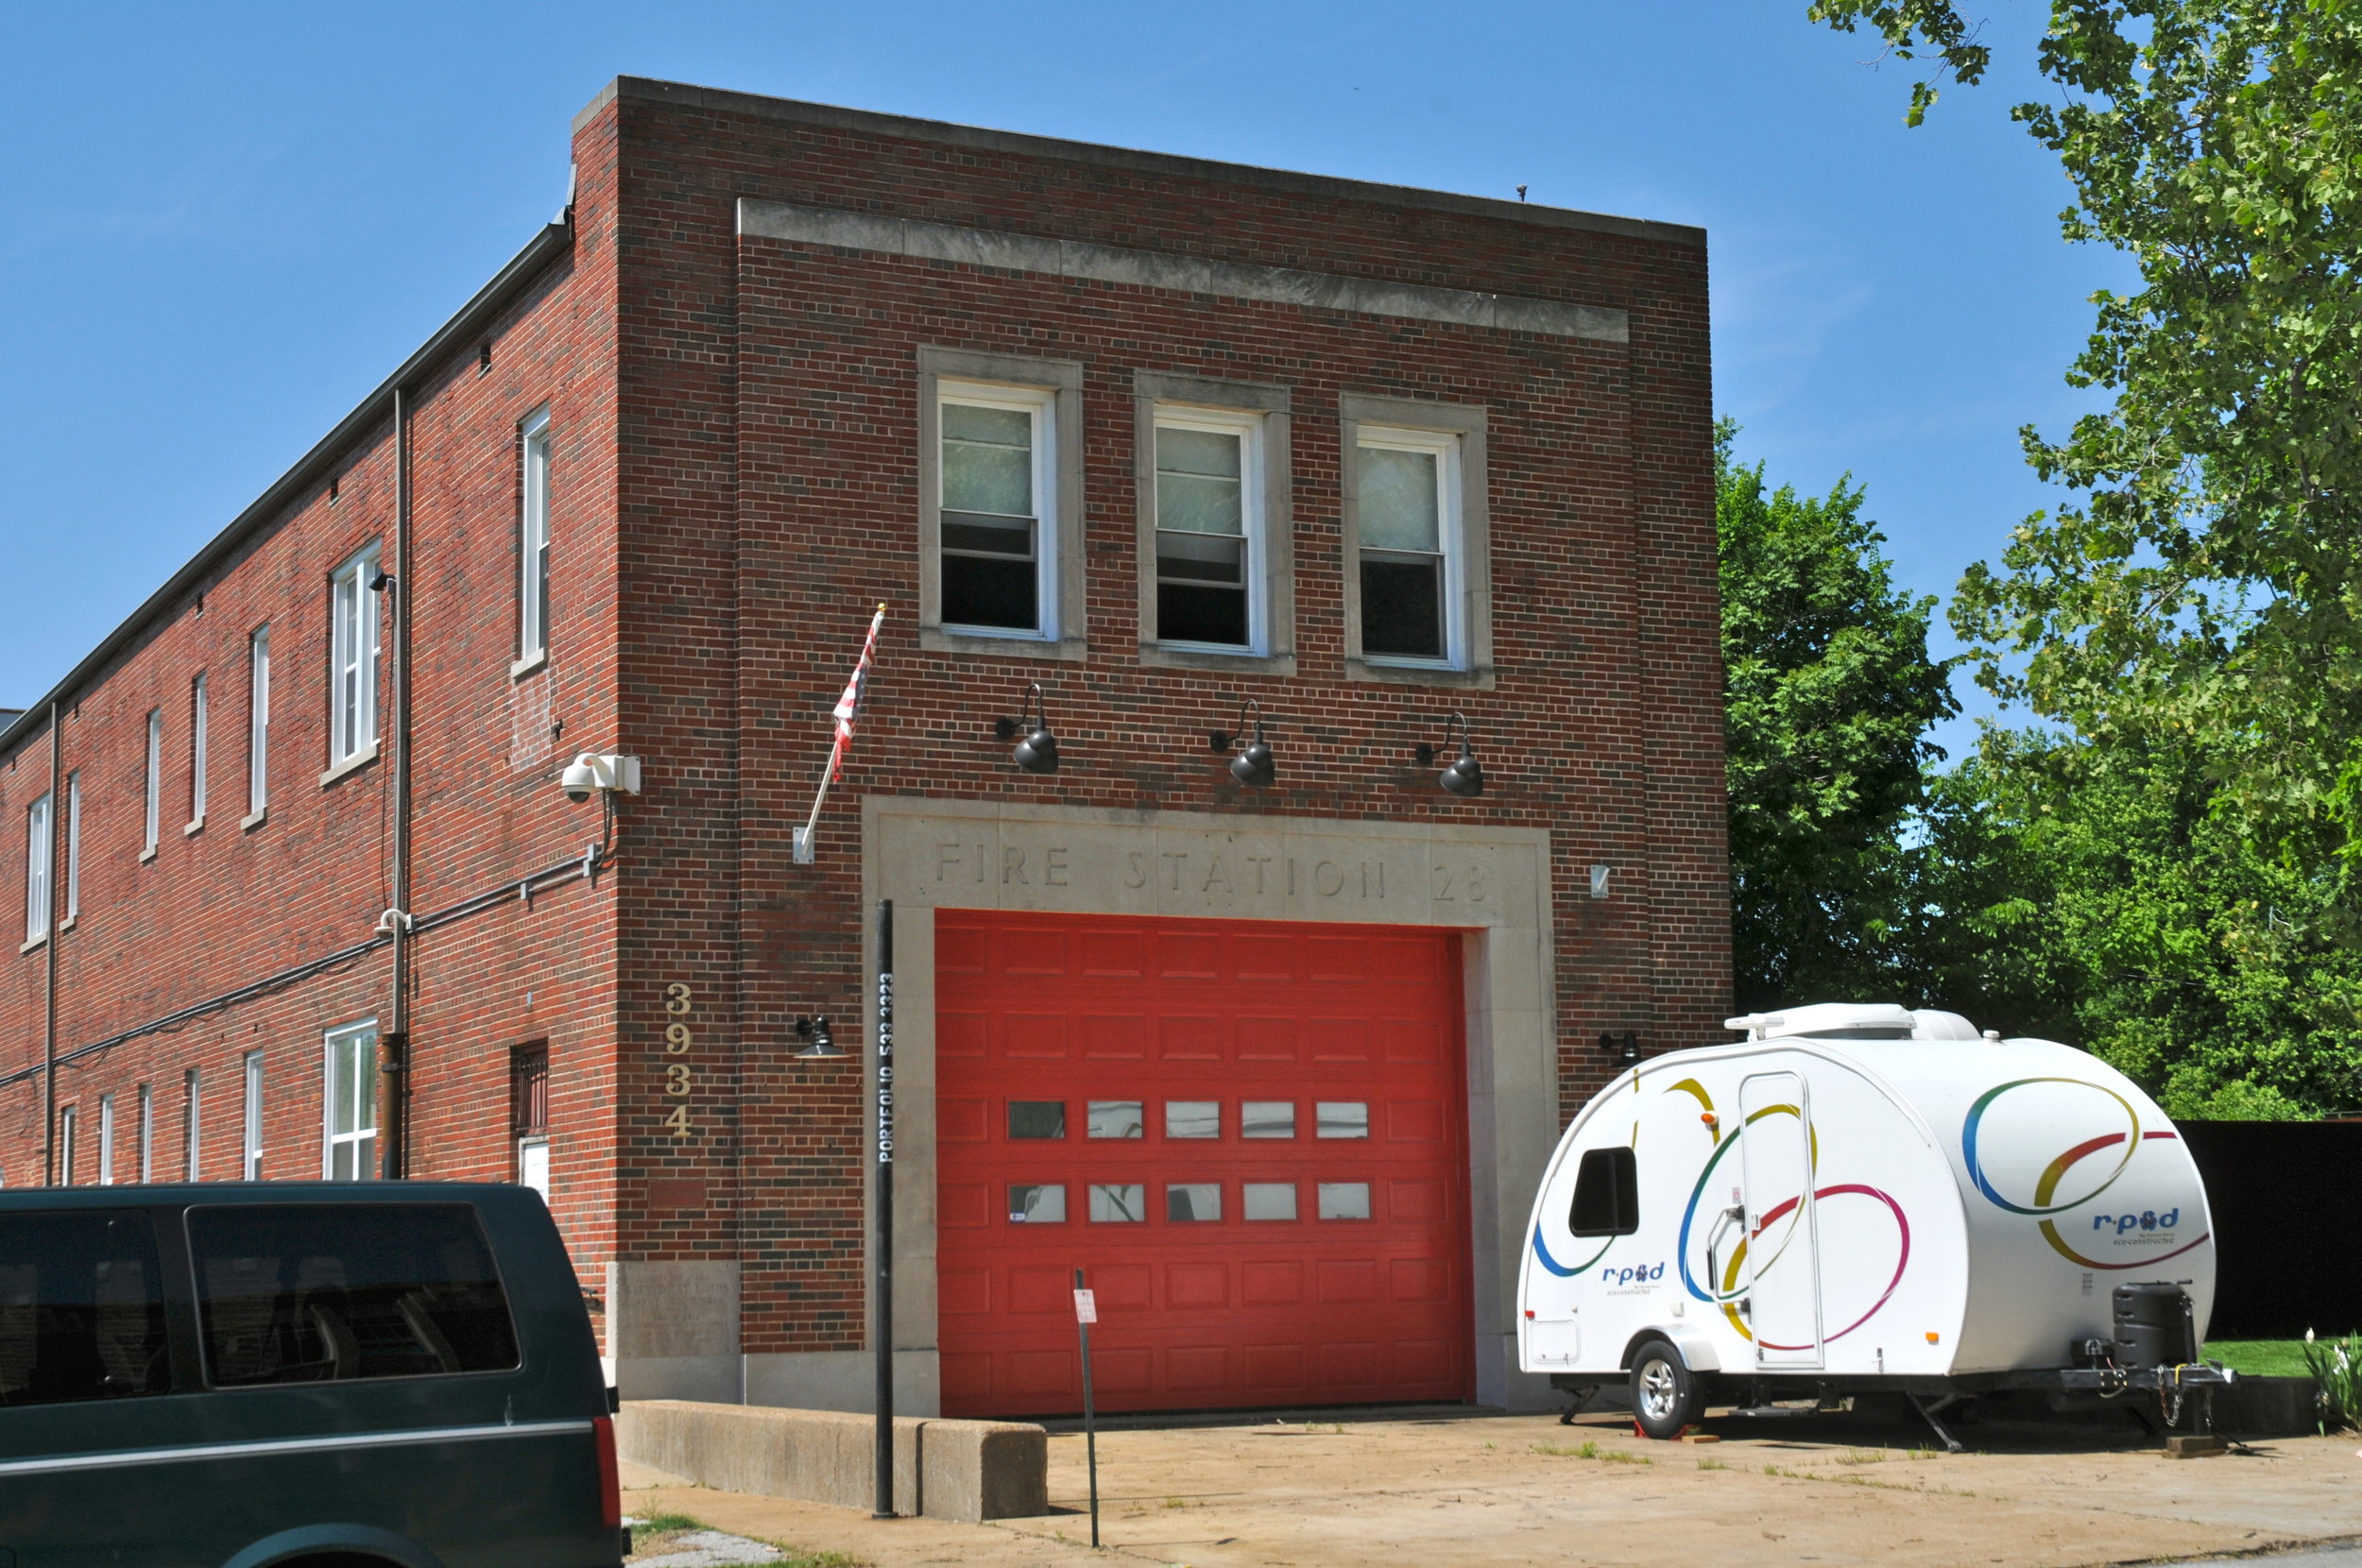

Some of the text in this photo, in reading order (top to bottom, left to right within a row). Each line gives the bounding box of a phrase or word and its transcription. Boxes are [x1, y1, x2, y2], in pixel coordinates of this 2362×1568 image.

[936, 843, 1487, 901] FIRE STATION 28
[664, 982, 692, 1137] 3934
[879, 972, 893, 1163] PORTFOLIO 533 3323
